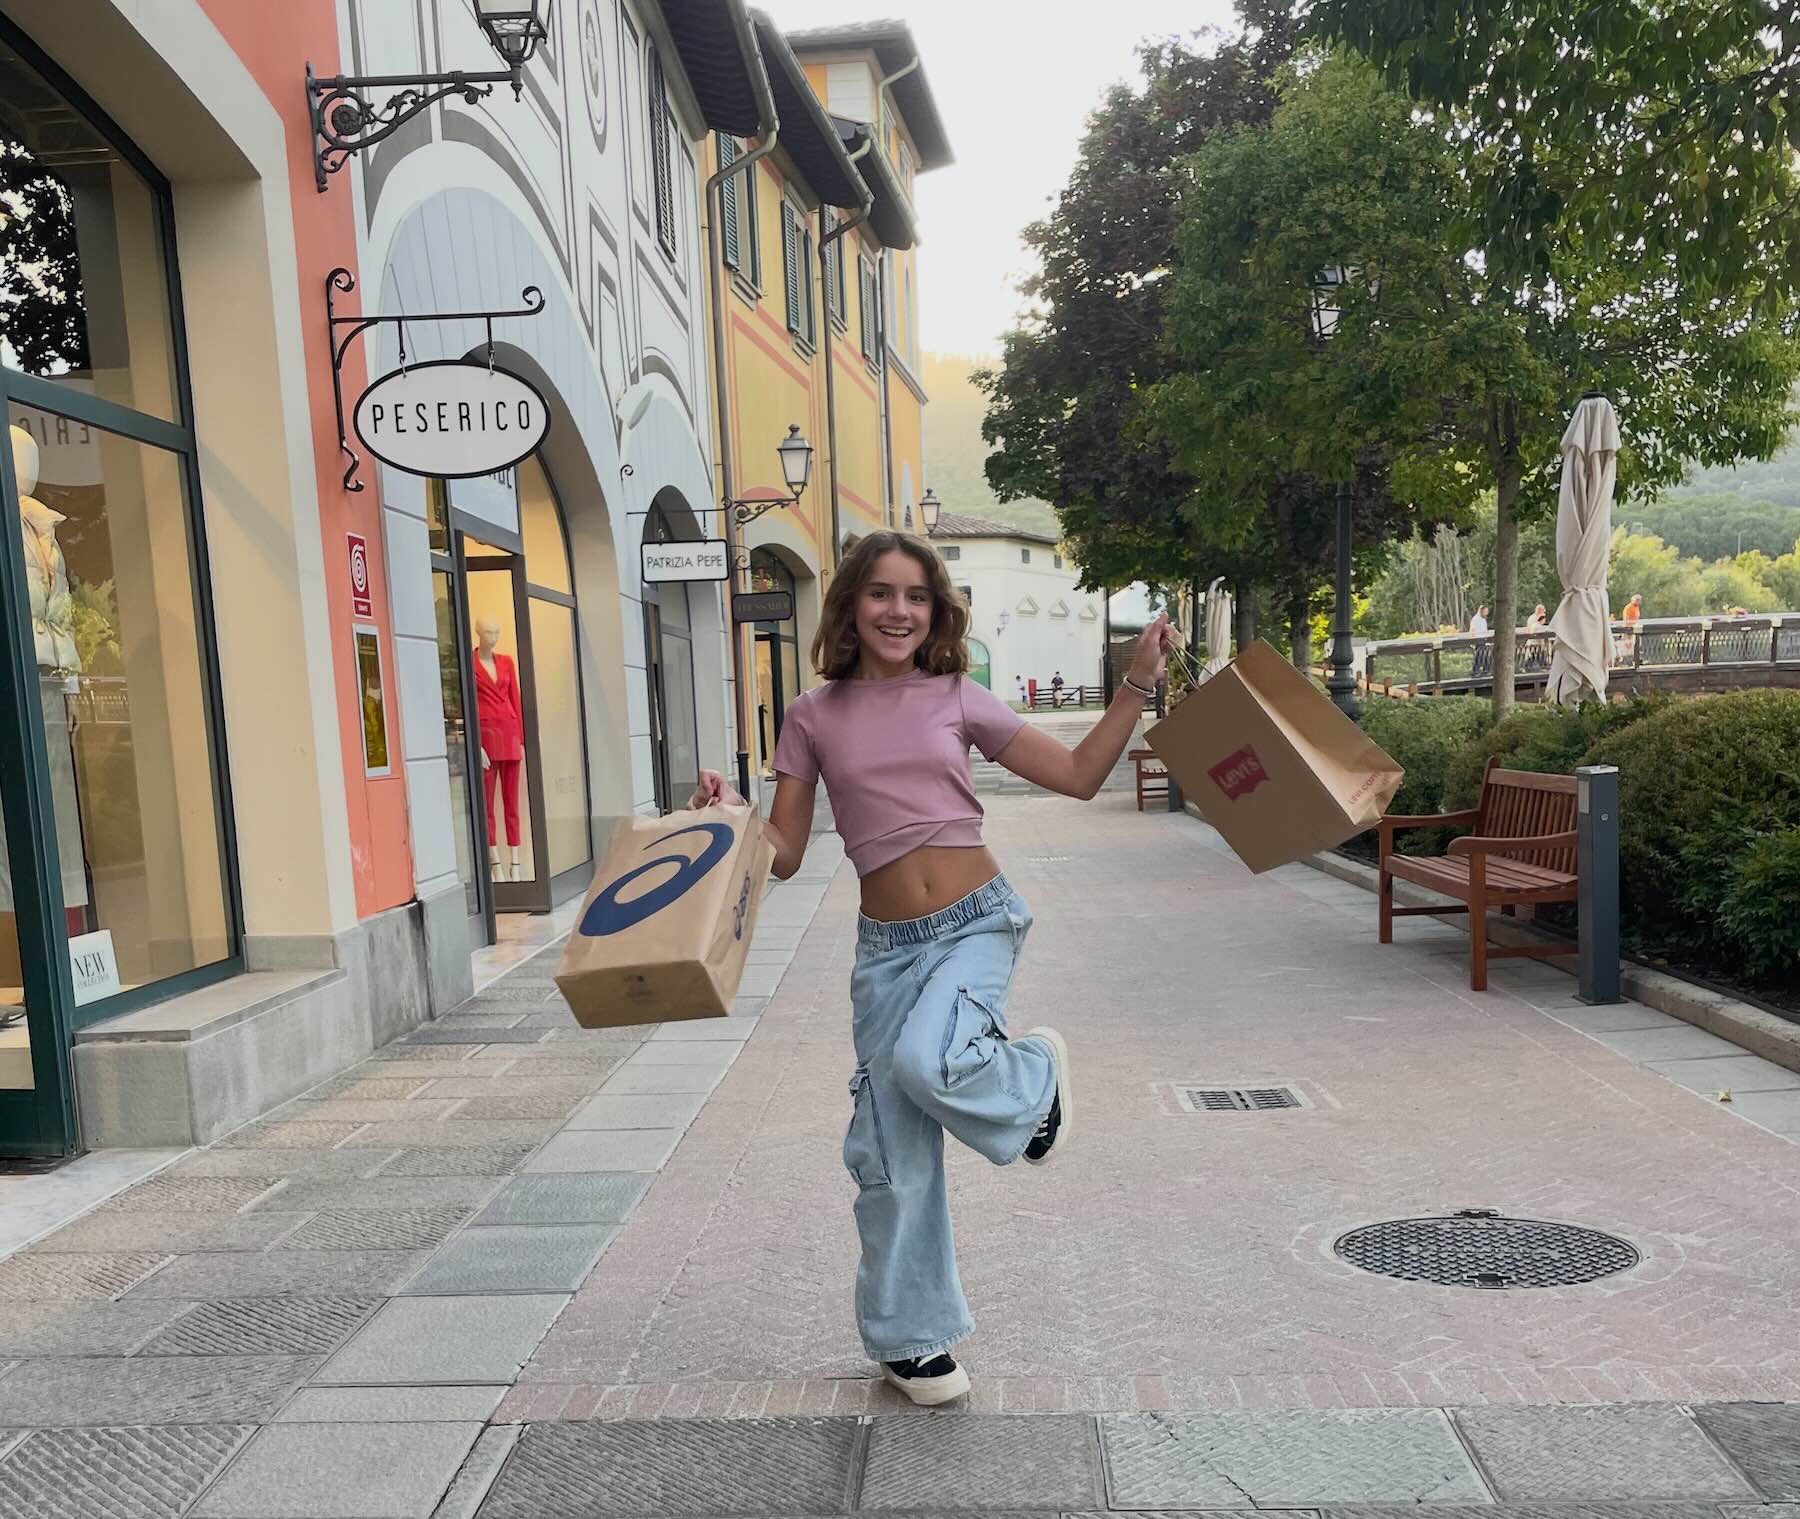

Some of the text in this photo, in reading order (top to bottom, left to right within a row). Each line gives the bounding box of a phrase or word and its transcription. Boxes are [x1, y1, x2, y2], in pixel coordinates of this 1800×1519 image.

[372, 400, 531, 434] PESERICO
[646, 554, 723, 569] PATRIZIA PEPE
[74, 952, 106, 977] NEW
